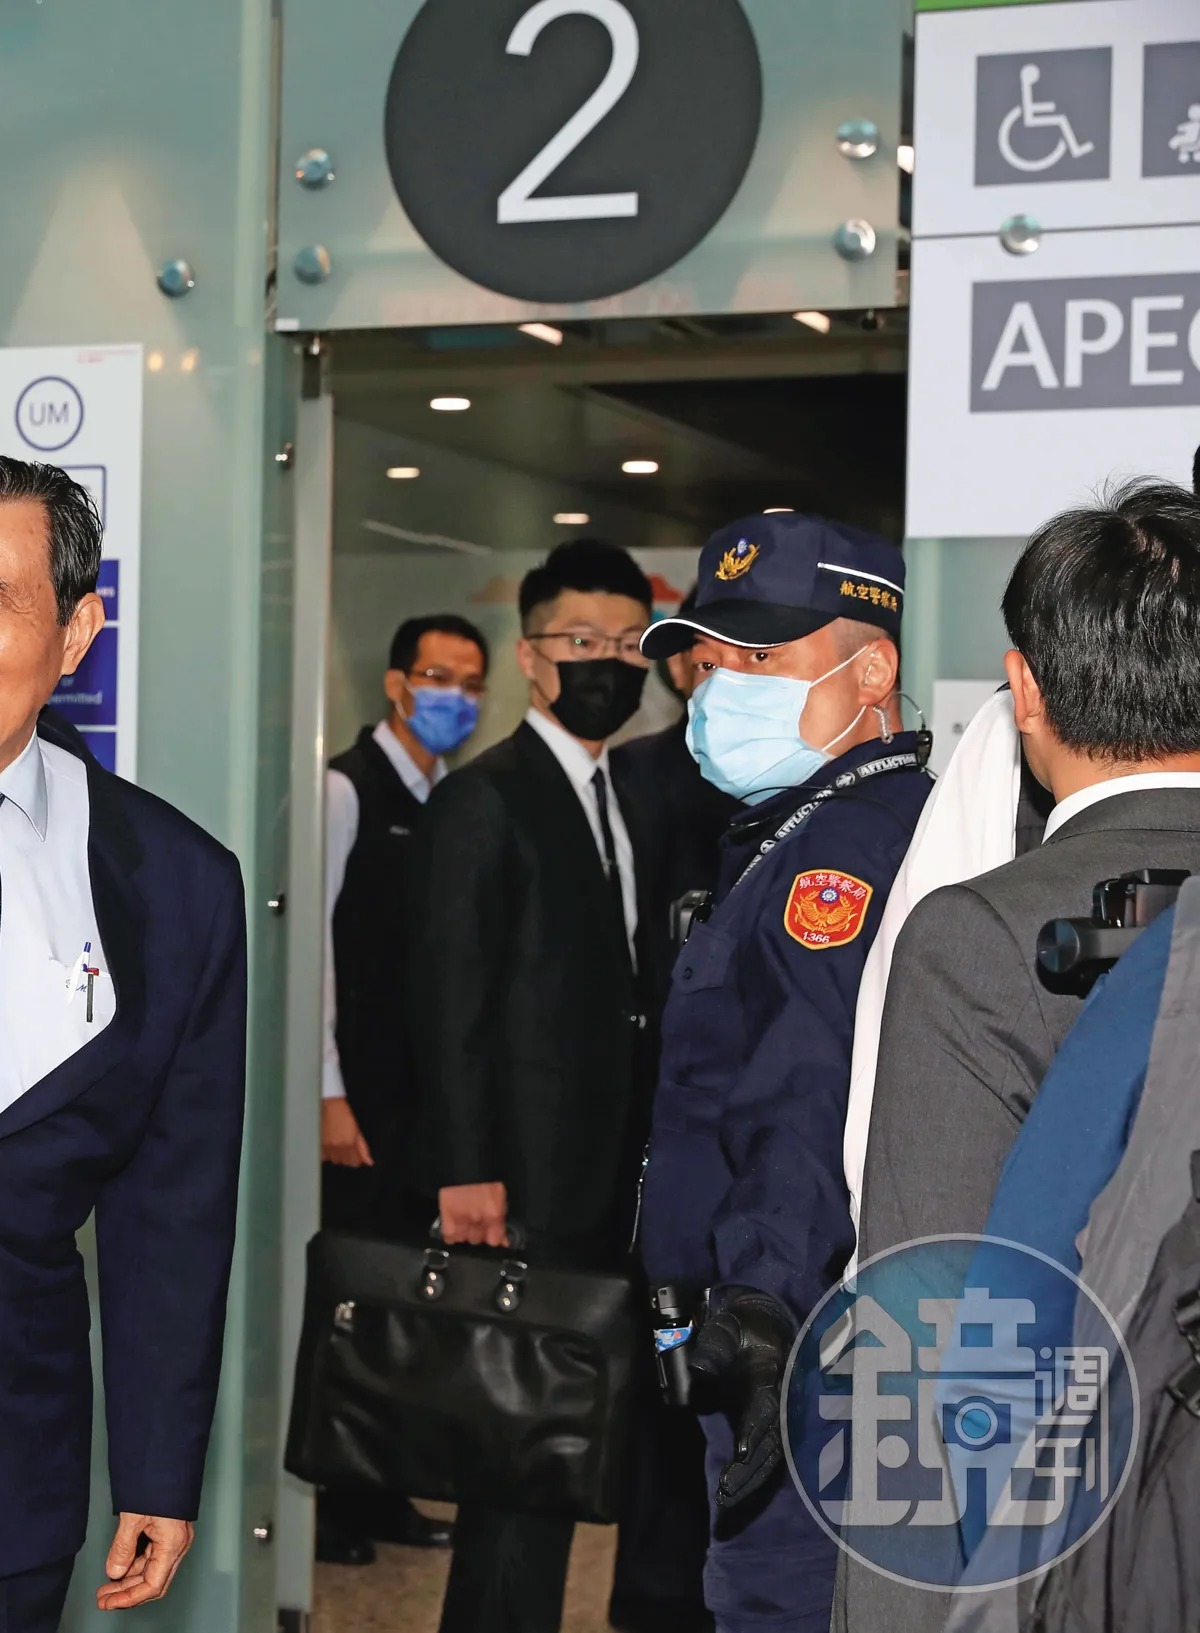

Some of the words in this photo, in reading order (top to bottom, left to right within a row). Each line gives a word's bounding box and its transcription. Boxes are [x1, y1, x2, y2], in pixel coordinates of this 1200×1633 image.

[497, 0, 640, 224] 2
[981, 295, 1200, 391] APE
[28, 402, 69, 426] UM
[840, 580, 898, 612] 航空警察局
[799, 873, 867, 900] 航空警察局
[803, 931, 831, 944] 1366
